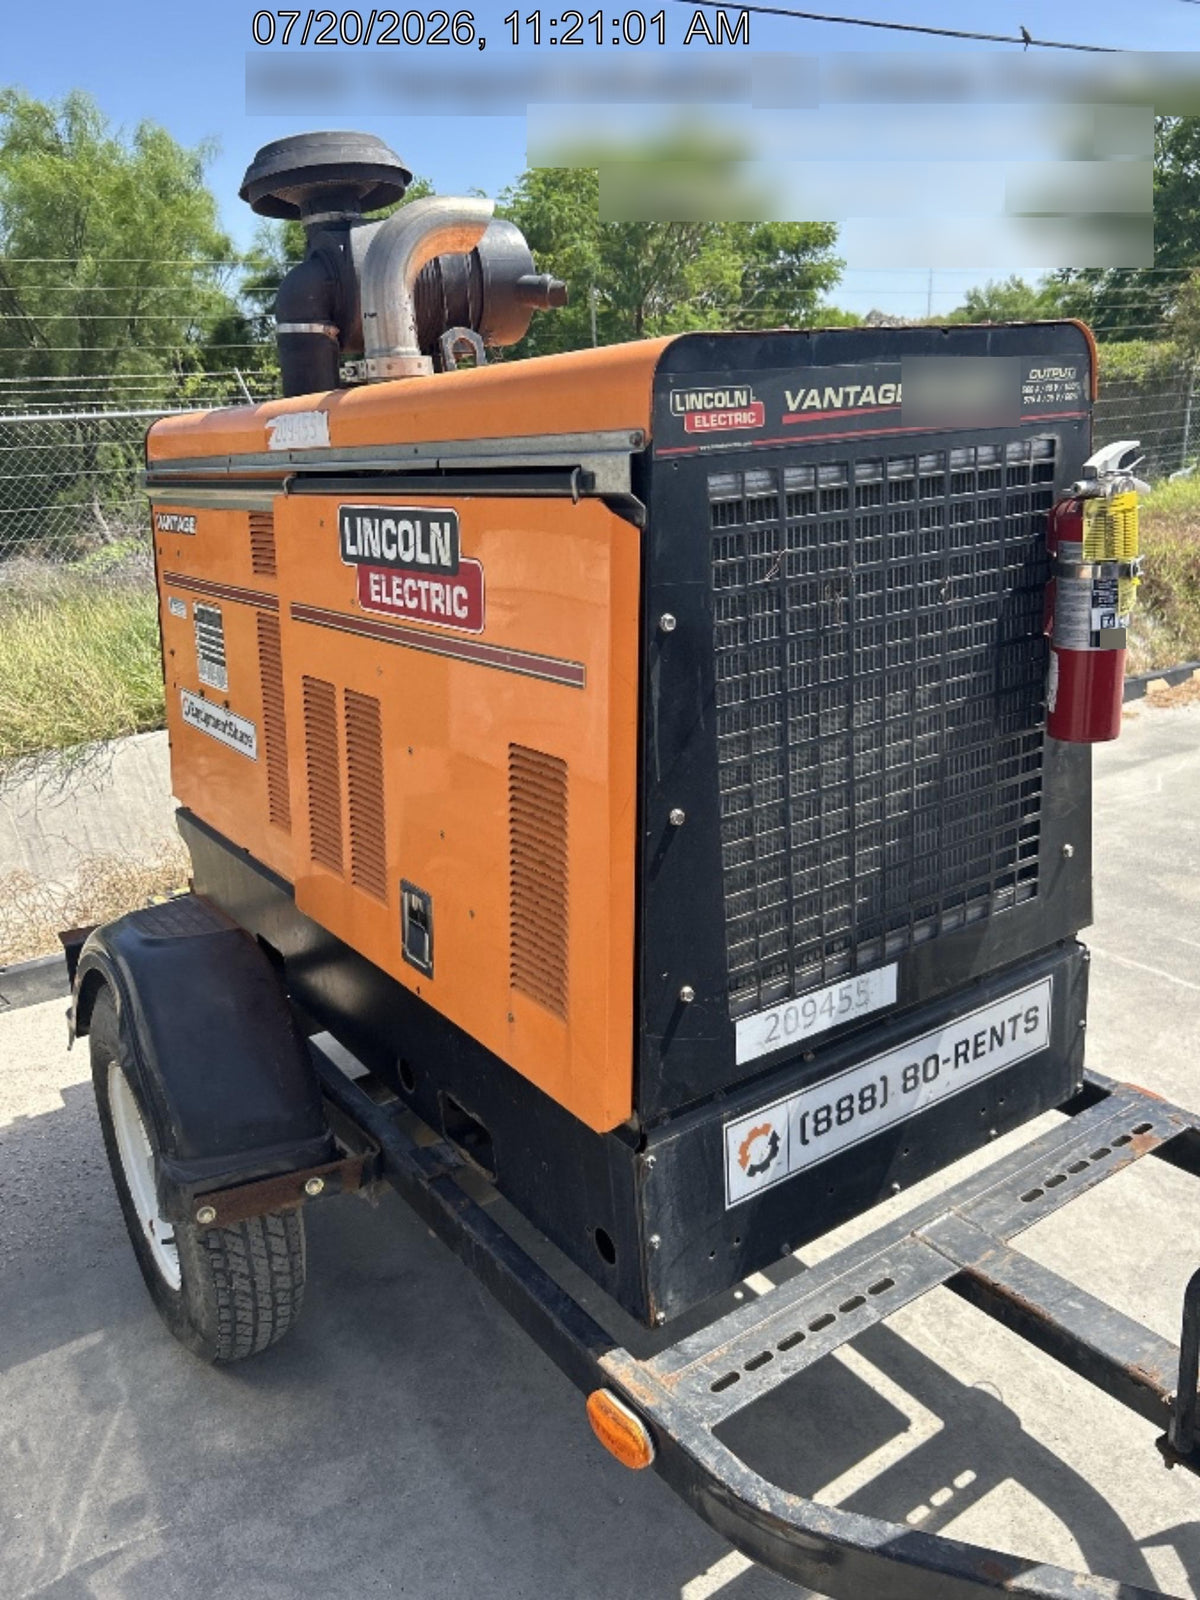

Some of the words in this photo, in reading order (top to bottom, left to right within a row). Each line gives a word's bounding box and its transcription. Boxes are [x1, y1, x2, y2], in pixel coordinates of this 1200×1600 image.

[675, 390, 747, 412] LINCOLN
[694, 411, 756, 428] ELECTRIC
[343, 516, 453, 567] LINCOLN
[369, 571, 469, 619] ELECTRIC
[799, 1075, 889, 1146] (888)
[902, 1005, 1040, 1095] 80-RENTS
